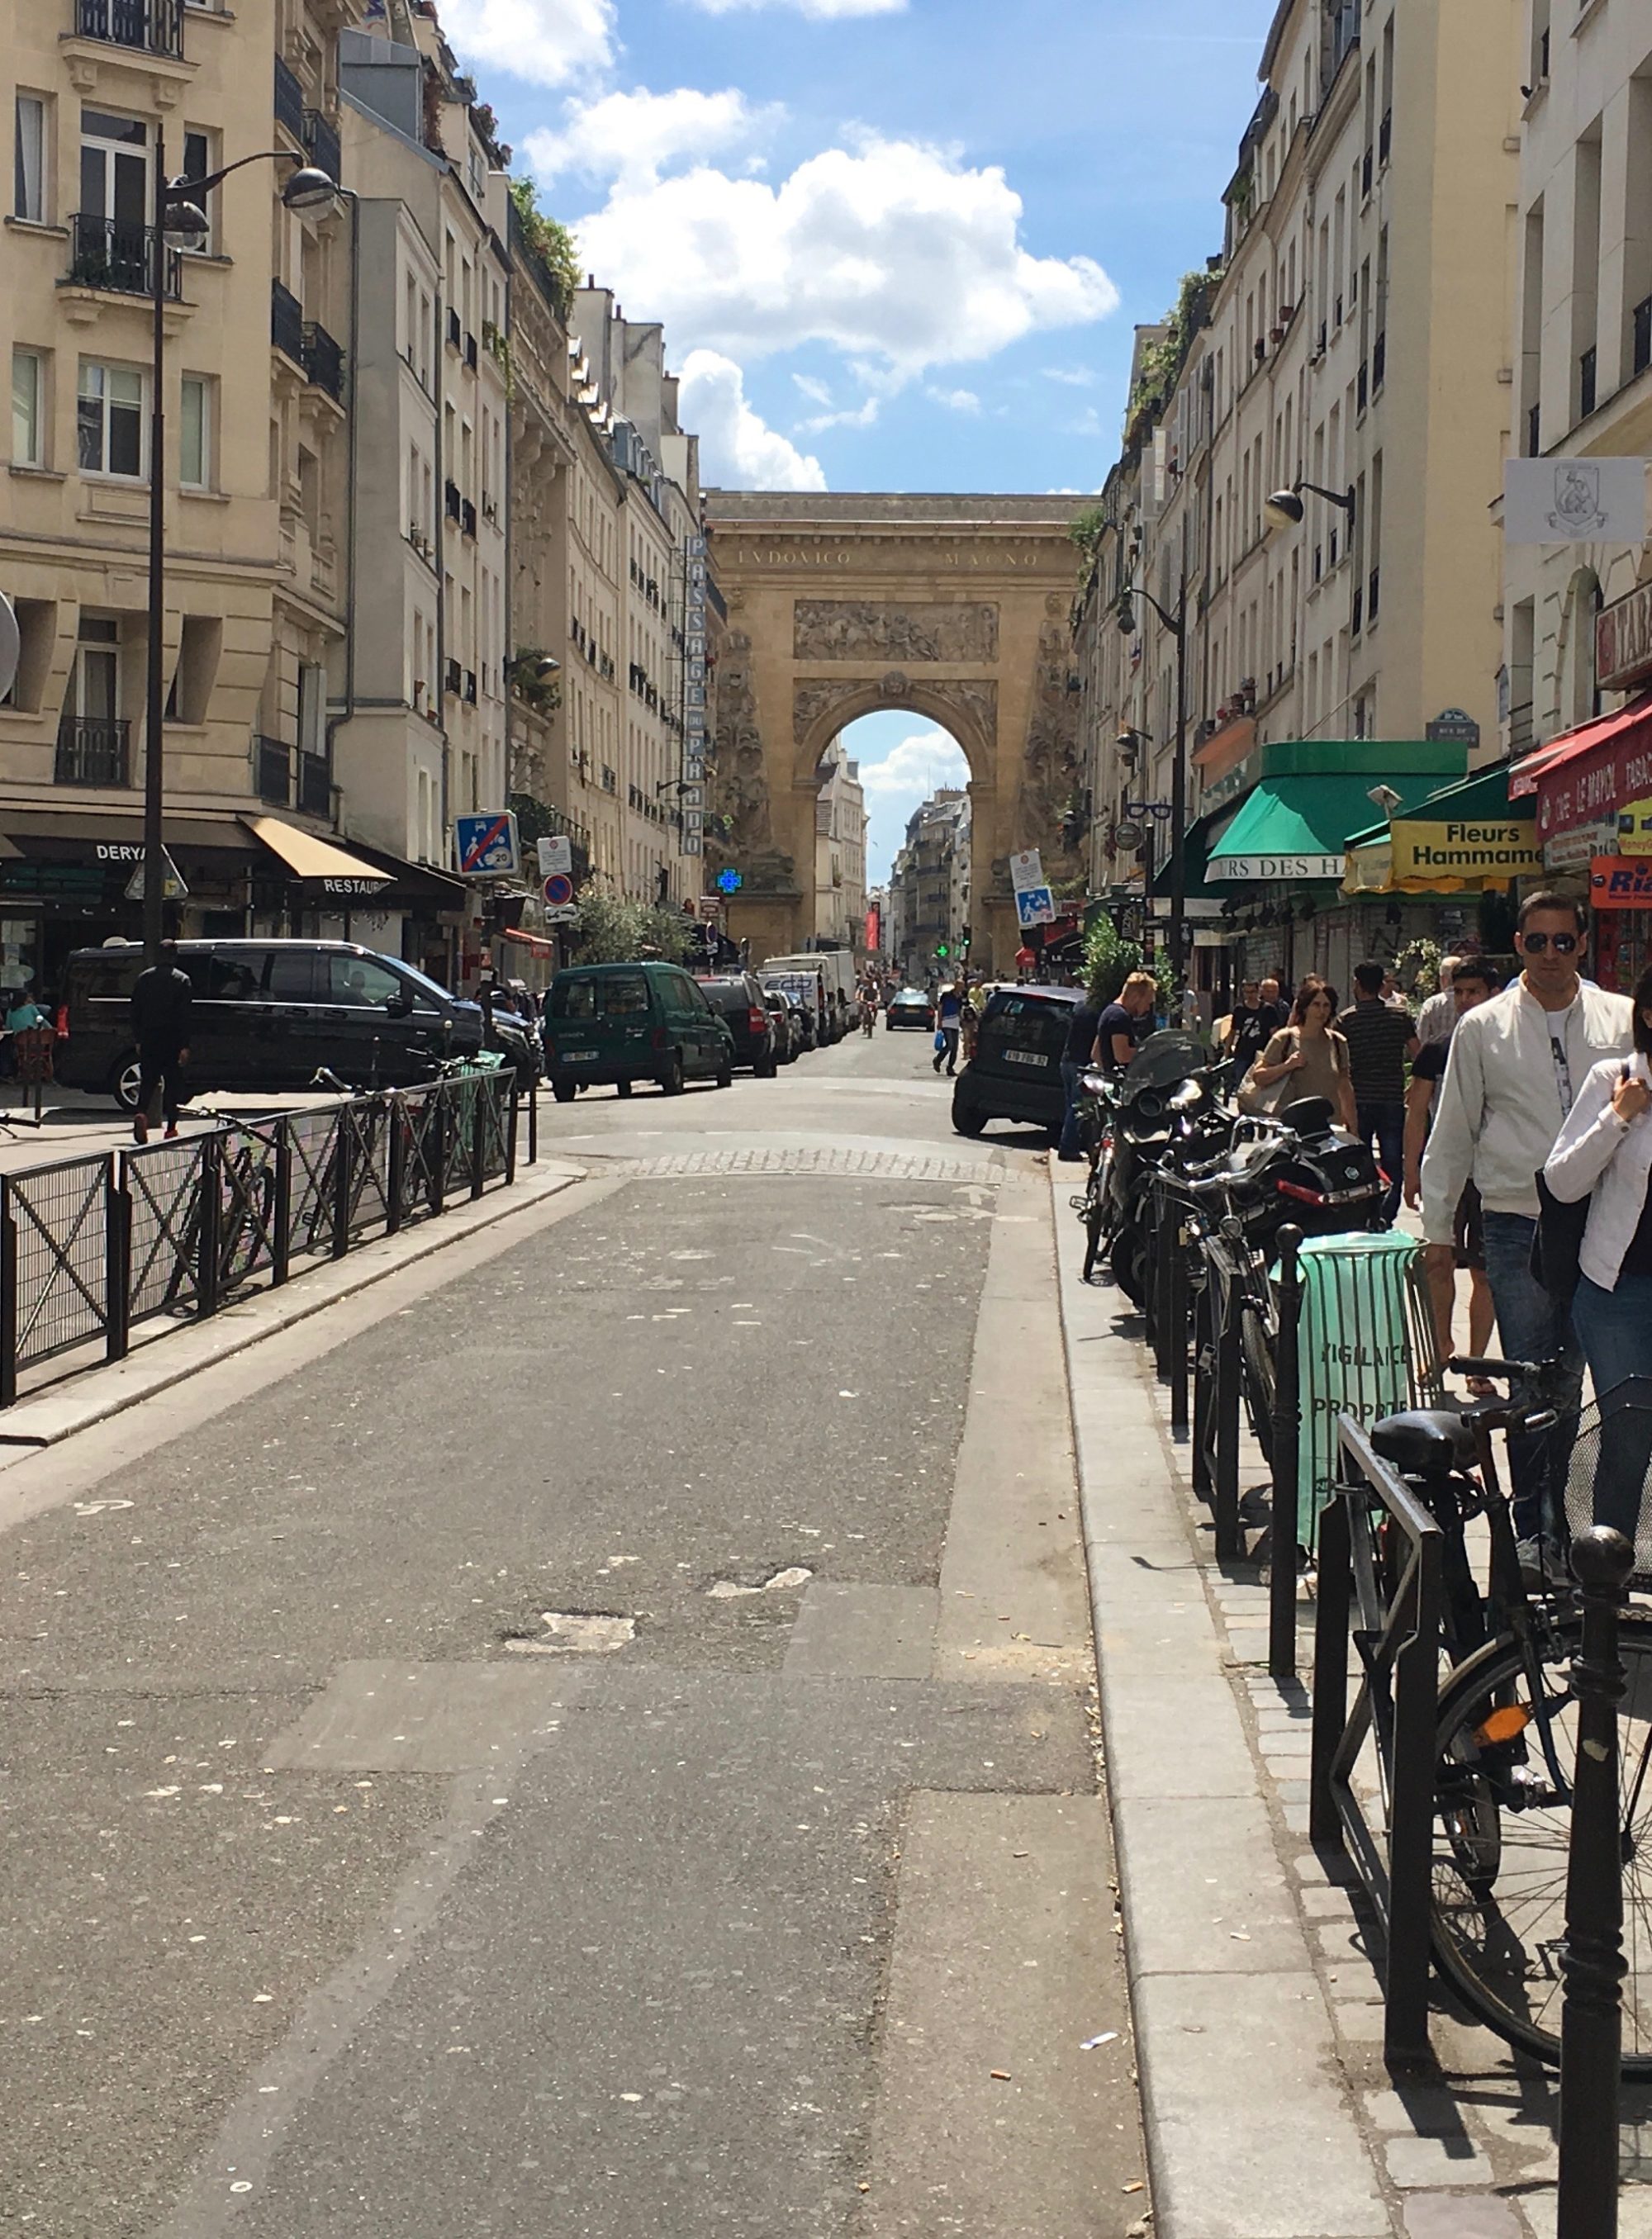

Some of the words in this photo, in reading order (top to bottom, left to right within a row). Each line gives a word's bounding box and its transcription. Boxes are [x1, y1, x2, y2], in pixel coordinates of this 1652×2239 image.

[691, 539, 703, 705] PASSAGE
[689, 716, 702, 726] DU
[686, 738, 701, 854] PRADO
[1446, 823, 1521, 843] Fleurs
[496, 853, 507, 862] 20
[1260, 858, 1308, 877] DES
